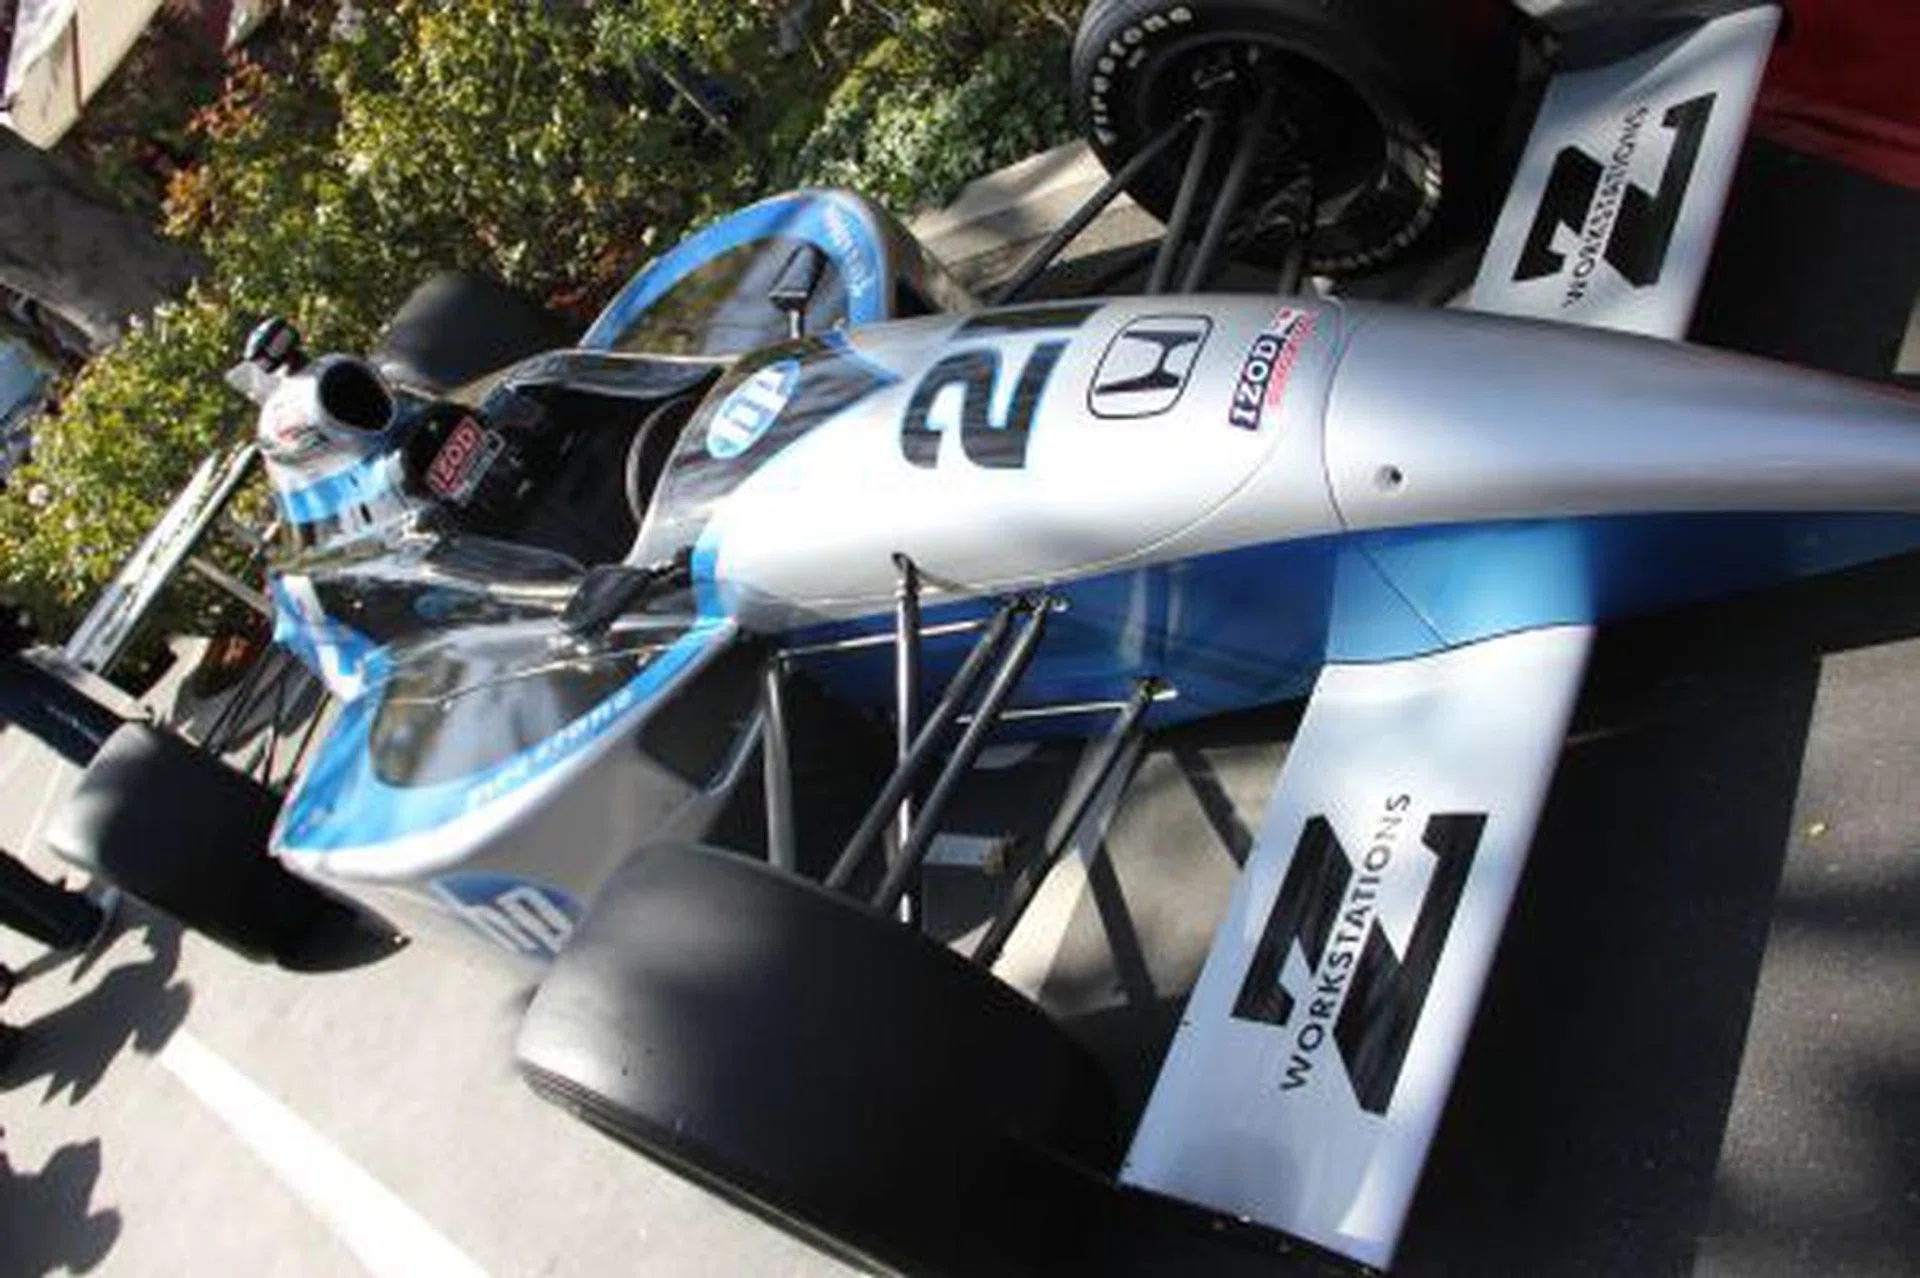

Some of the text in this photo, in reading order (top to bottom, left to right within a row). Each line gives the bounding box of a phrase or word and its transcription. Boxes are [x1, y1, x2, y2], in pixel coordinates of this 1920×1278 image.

[1560, 103, 1648, 308] WORKSTATIONS
[1231, 337, 1280, 424] IZOD
[429, 422, 480, 494] IZOD
[1281, 792, 1411, 1092] WORKSTATIONS
